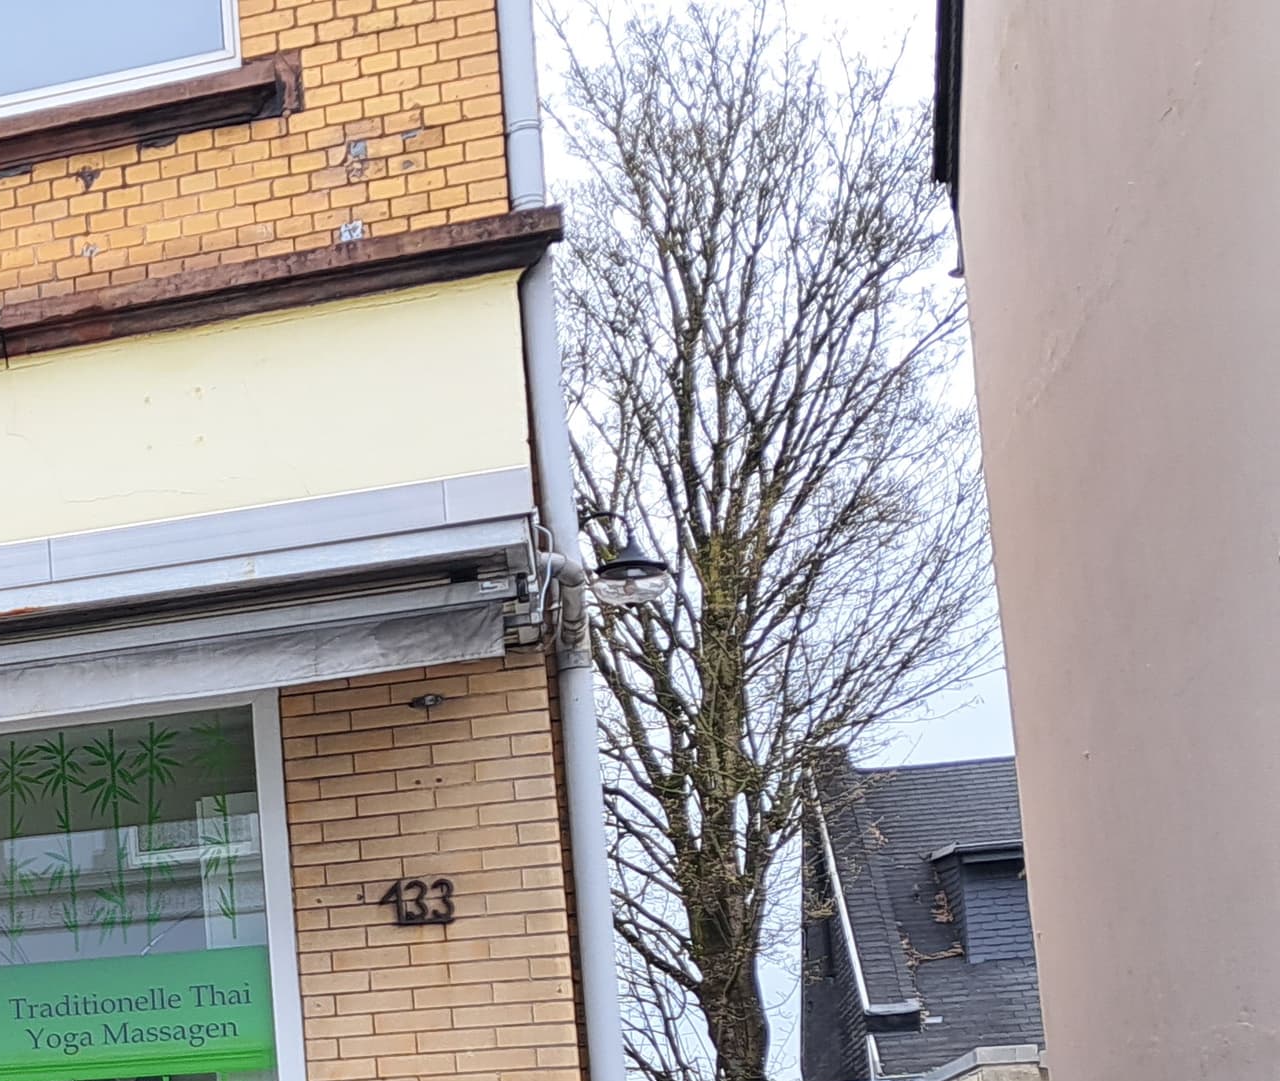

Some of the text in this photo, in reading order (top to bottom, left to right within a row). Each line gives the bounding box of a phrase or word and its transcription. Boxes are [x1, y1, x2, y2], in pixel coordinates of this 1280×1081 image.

[9, 982, 252, 1020] Traditionelle Thai
[25, 1021, 238, 1056] Yoga Massagen
